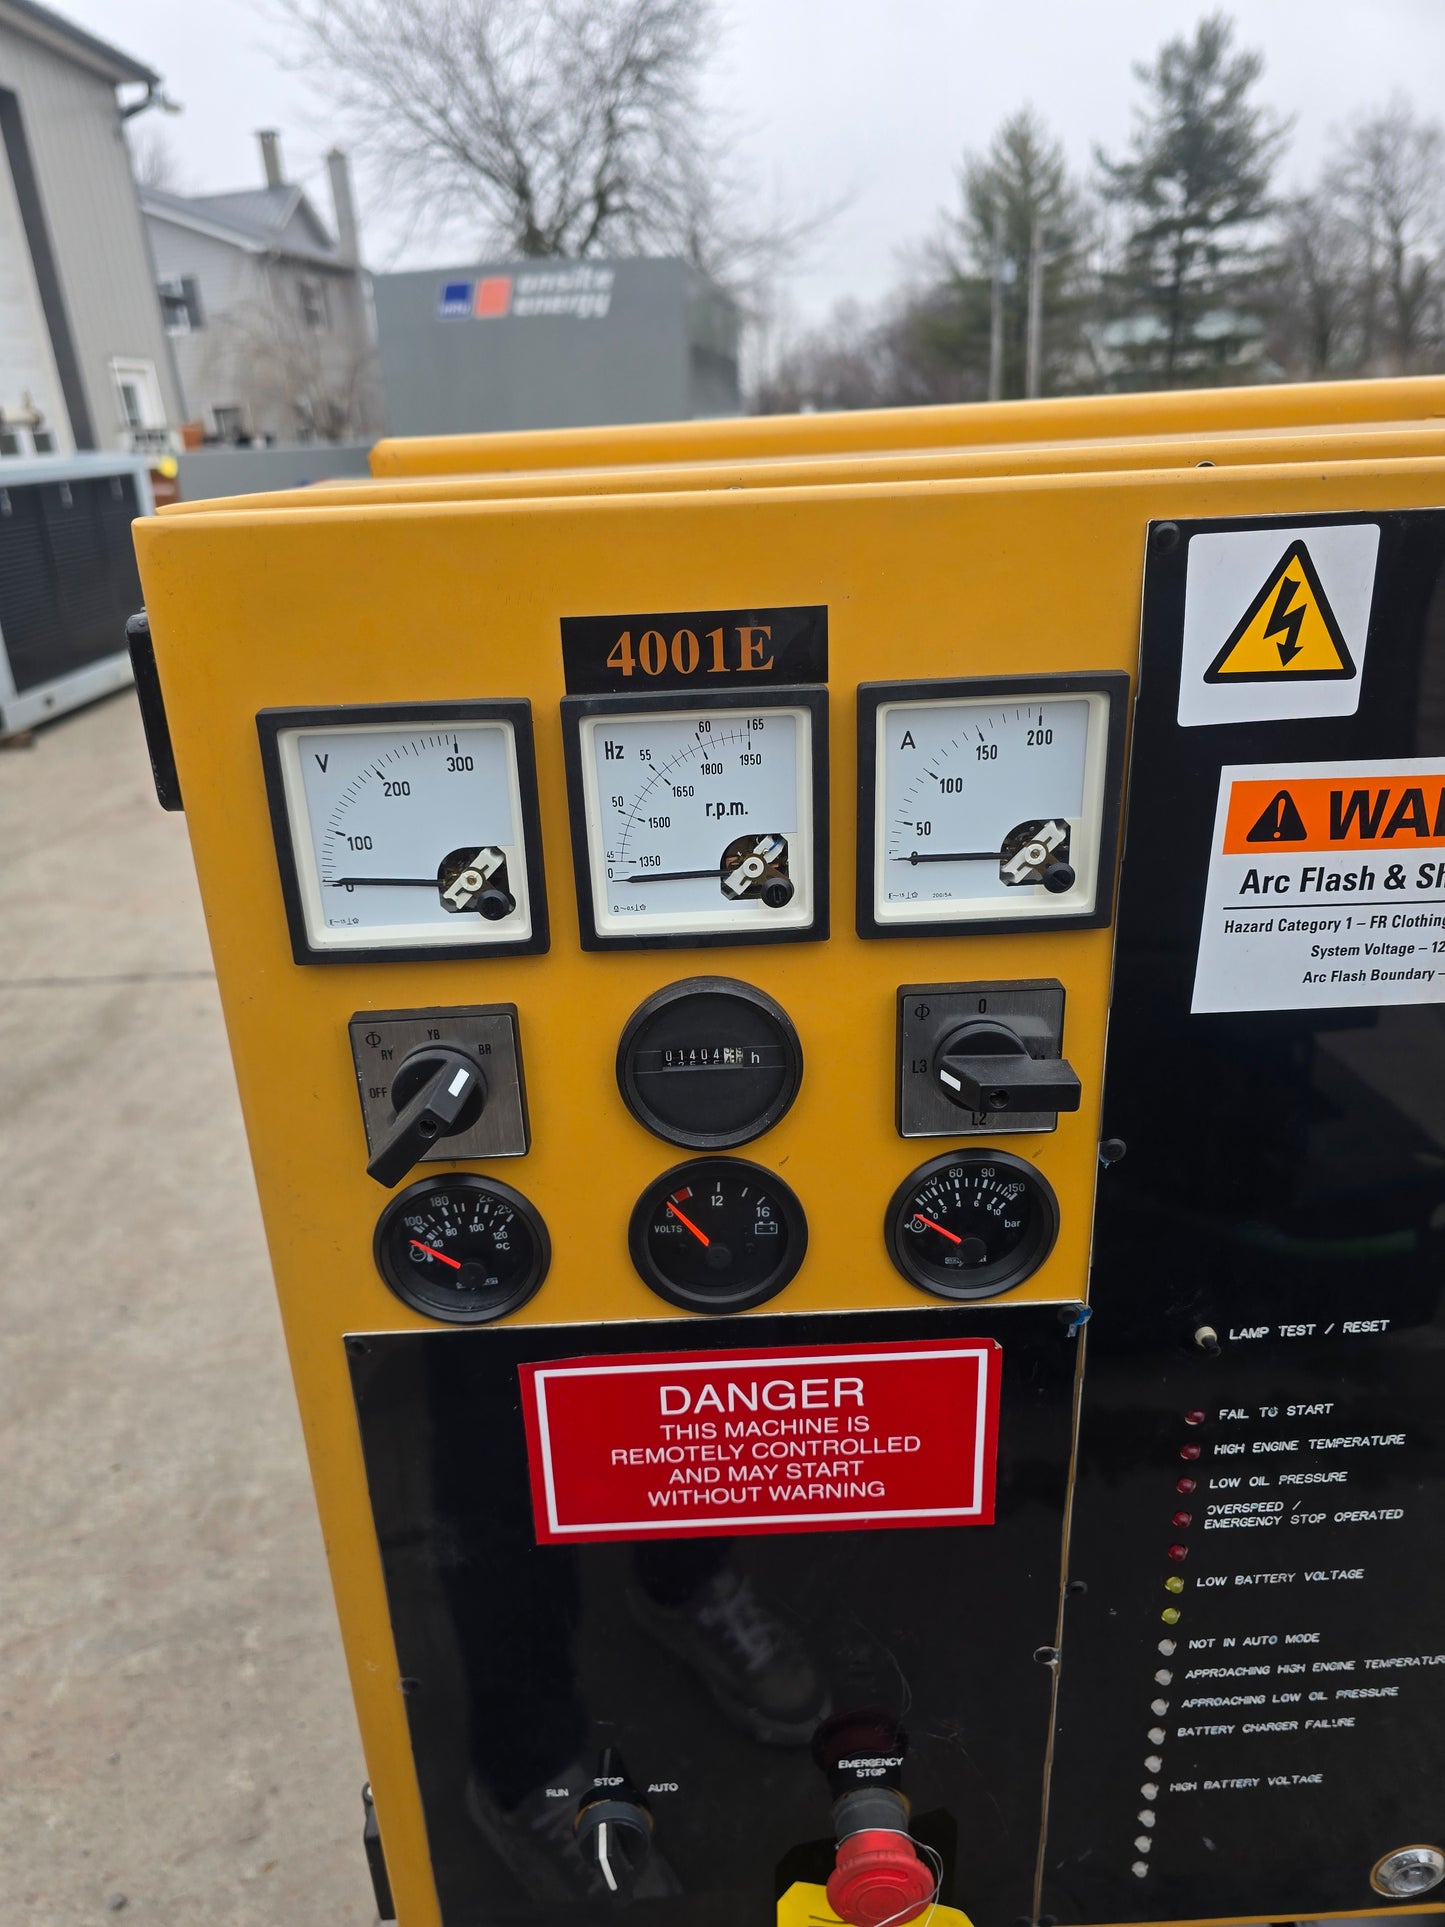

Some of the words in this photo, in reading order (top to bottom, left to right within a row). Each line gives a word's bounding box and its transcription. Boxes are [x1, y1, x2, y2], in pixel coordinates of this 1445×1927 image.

[606, 625, 775, 677] 4001E
[698, 720, 711, 733] 60
[751, 718, 765, 731] 65
[900, 730, 916, 750] A
[1026, 729, 1053, 747] 200
[604, 741, 625, 761] Hz
[639, 749, 652, 762] 55
[975, 744, 998, 761] 150
[314, 754, 329, 773] V
[446, 756, 474, 772] 300
[739, 753, 762, 767] 1950
[700, 763, 724, 776] 1800
[382, 780, 411, 797] 200
[671, 785, 695, 798] 1650
[939, 777, 963, 794] 100
[611, 795, 625, 808] 50
[704, 802, 749, 820] r.p.m.
[1330, 788, 1445, 840] WA
[648, 816, 671, 829] 1500
[916, 821, 932, 836] 50
[346, 835, 373, 851] 100
[606, 850, 615, 859] 45
[639, 855, 661, 868] 1350
[607, 867, 614, 879] 0
[1239, 869, 1290, 895] Arc
[1299, 865, 1376, 893] Flash
[1383, 864, 1407, 890] &
[1224, 919, 1273, 934] Hazard
[1278, 917, 1341, 934] Category
[1345, 917, 1353, 930] 1
[1369, 916, 1387, 929] FR
[1310, 945, 1360, 960] System
[1364, 942, 1415, 957] Voltage
[1302, 971, 1327, 983] Arc
[1330, 970, 1366, 982] Flash
[1370, 968, 1435, 983] Boundary
[978, 998, 987, 1014] 0
[426, 1029, 441, 1041] YB
[381, 1049, 393, 1061] RY
[478, 1043, 492, 1055] BR
[750, 1051, 760, 1064] h
[912, 1060, 928, 1074] L3
[369, 1087, 388, 1099] OFF
[971, 1112, 987, 1126] L2
[949, 1167, 963, 1178] 60
[981, 1167, 995, 1178] 90
[1008, 1182, 1026, 1193] 150
[711, 1195, 724, 1206] 12
[404, 1215, 423, 1227] 100
[430, 1195, 449, 1207] 180
[666, 1207, 674, 1218] 8
[756, 1206, 770, 1218] 16
[933, 1212, 939, 1220] 0
[942, 1206, 948, 1214] 2
[956, 1200, 961, 1208] 4
[974, 1200, 979, 1208] 6
[987, 1203, 992, 1211] 8
[993, 1208, 1001, 1216] 10
[654, 1224, 683, 1234] VOLTS
[1004, 1219, 1021, 1228] bar
[432, 1239, 444, 1248] 40
[446, 1228, 458, 1237] 80
[469, 1223, 485, 1233] 100
[493, 1231, 508, 1240] 120
[1229, 1326, 1269, 1341] LAMP
[1278, 1323, 1316, 1337] TEST
[1324, 1322, 1335, 1335] /
[1342, 1319, 1390, 1334] RESET
[660, 1377, 865, 1416] DANGER
[1219, 1408, 1249, 1420] FAIL
[1259, 1406, 1279, 1418] TO
[1286, 1403, 1334, 1416] START
[660, 1422, 717, 1441] THIS
[724, 1417, 839, 1439] MACHINE
[848, 1416, 870, 1433] IS
[611, 1443, 745, 1466] REMOTELY
[752, 1435, 921, 1459] CONTROLLED
[1214, 1443, 1245, 1456] HIGH
[1252, 1440, 1299, 1454] ENGINE
[1308, 1434, 1406, 1449] TEMPERATURE
[669, 1464, 721, 1484] AND
[728, 1463, 781, 1482] MAY
[786, 1460, 864, 1480] START
[1209, 1477, 1242, 1489] LOW
[1249, 1475, 1270, 1487] OIL
[1278, 1471, 1348, 1485] PRESSURE
[648, 1485, 763, 1508] WITHOUT
[769, 1481, 886, 1503] WARNING
[1206, 1501, 1284, 1515] OVERSPEED
[1292, 1501, 1301, 1511] /
[1204, 1515, 1282, 1529] EMERGENCY
[1290, 1512, 1327, 1525] STOP
[1334, 1508, 1404, 1523] OPERATED
[1196, 1576, 1228, 1587] LOW
[1234, 1572, 1296, 1586] BATTERY
[1304, 1569, 1365, 1582] VOLTAGE
[1188, 1638, 1216, 1649] NOT
[1223, 1637, 1236, 1648] IN
[1242, 1635, 1278, 1646] AUTO
[1285, 1632, 1320, 1644] MODE
[1185, 1665, 1271, 1680] APPROACHING
[1277, 1662, 1306, 1674] HIGH
[1312, 1660, 1356, 1673] ENGINE
[1181, 1694, 1266, 1709] APPROACHING
[1272, 1692, 1301, 1704] LOW
[1308, 1690, 1328, 1702] OIL
[1336, 1686, 1399, 1700] PRESSURE
[1177, 1724, 1236, 1738] BATTERY
[1242, 1720, 1298, 1734] CHARGER
[1305, 1717, 1356, 1730] FAILURE
[838, 1756, 904, 1769] EMERGENCY
[856, 1767, 887, 1778] STOP
[593, 1776, 624, 1787] STOP
[648, 1782, 679, 1793] AUTO
[1170, 1781, 1197, 1792] HIGH
[1204, 1777, 1260, 1790] BATTERY
[1267, 1773, 1324, 1787] VOLTAGE
[545, 1787, 569, 1798] RUN
